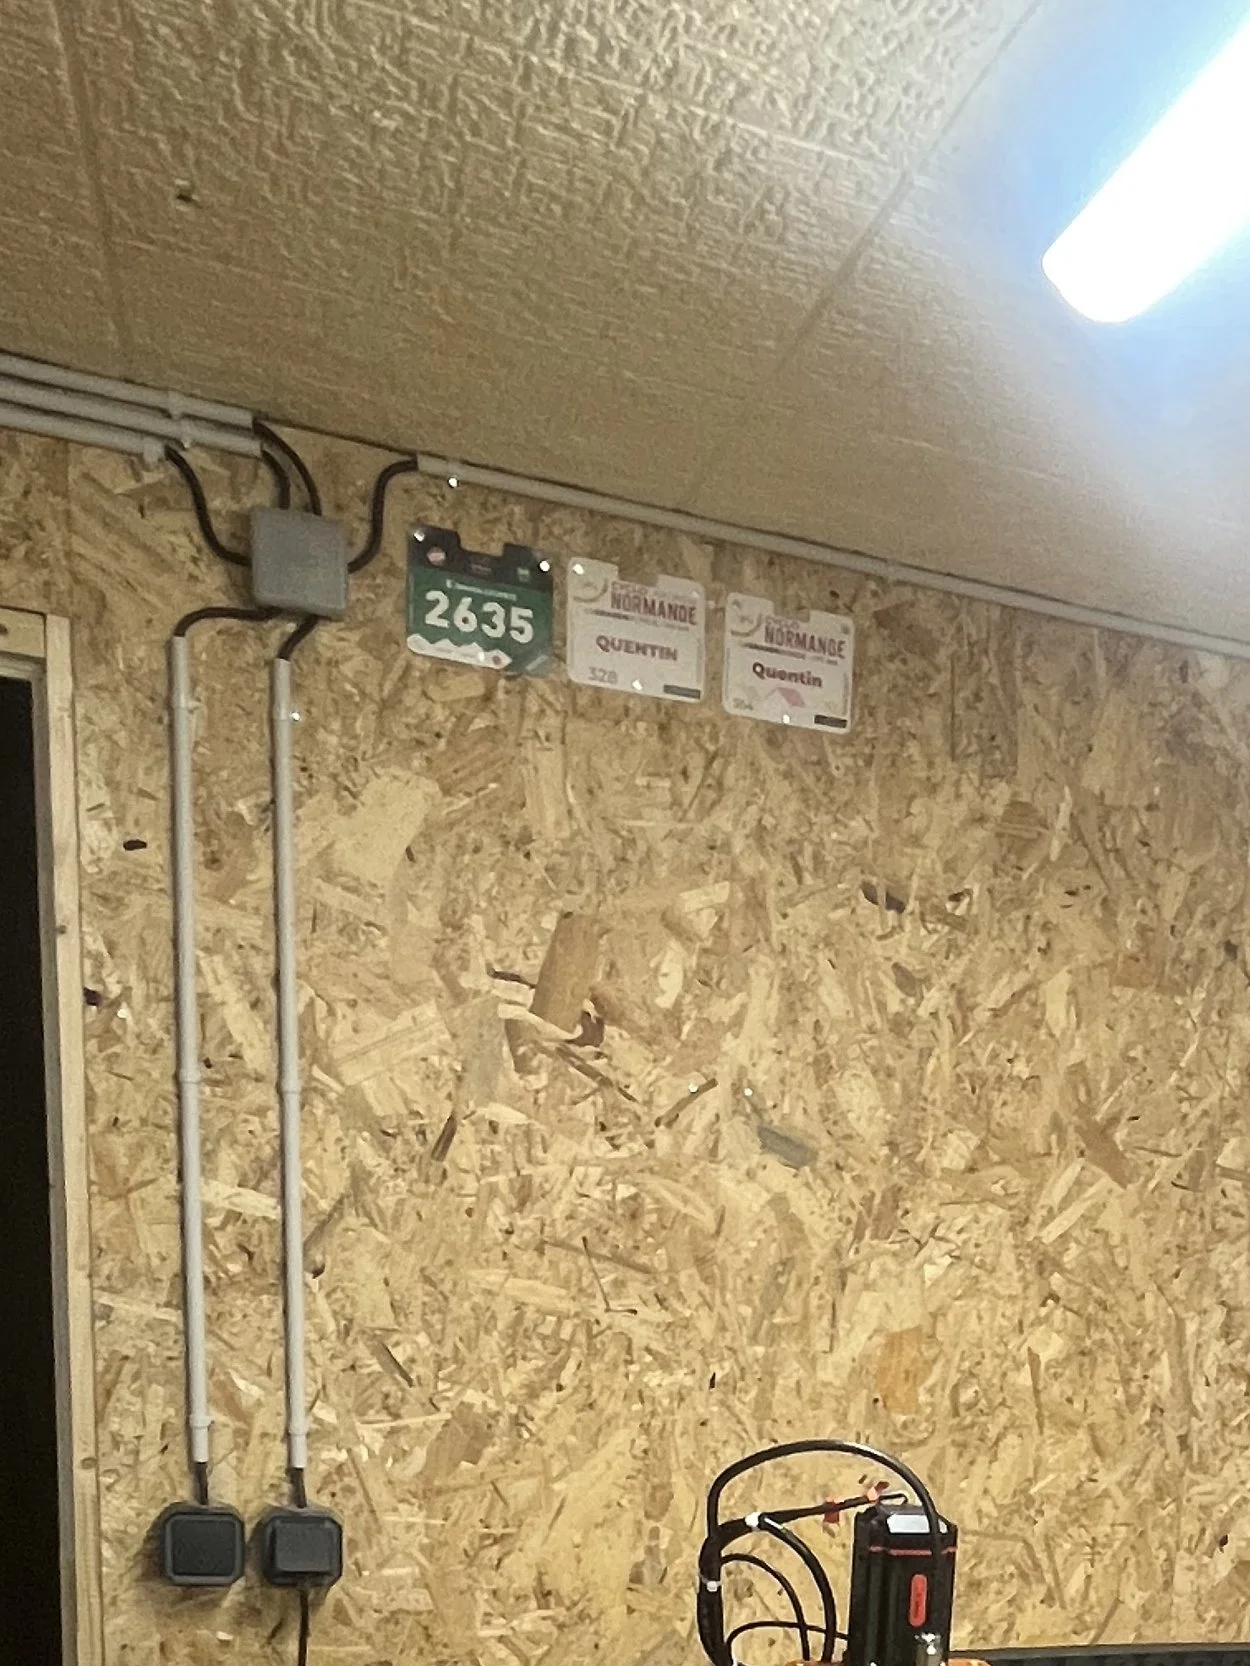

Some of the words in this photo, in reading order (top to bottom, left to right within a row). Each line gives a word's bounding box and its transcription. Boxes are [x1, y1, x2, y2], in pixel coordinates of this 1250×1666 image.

[424, 590, 534, 644] 2635
[610, 591, 697, 626] NORMANDE
[595, 634, 678, 662] QUENTIN
[752, 661, 823, 689] Quentin
